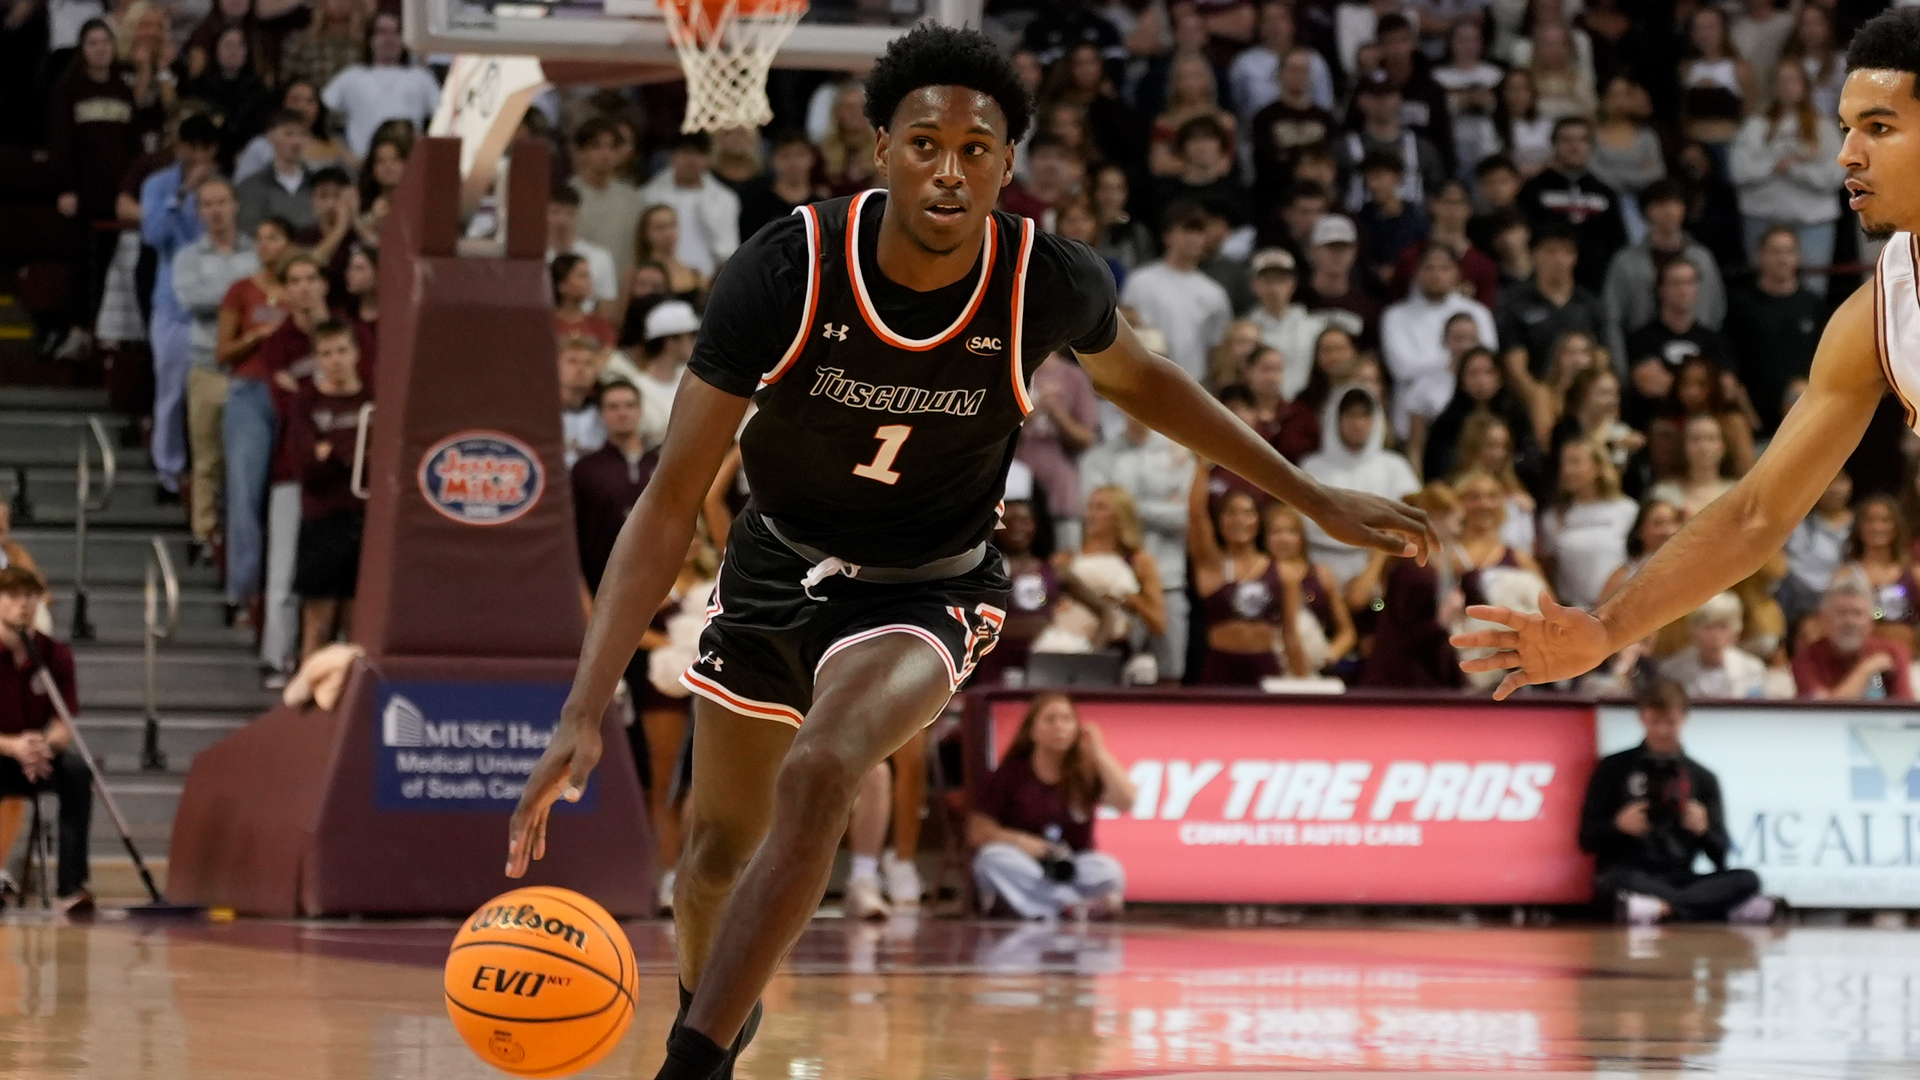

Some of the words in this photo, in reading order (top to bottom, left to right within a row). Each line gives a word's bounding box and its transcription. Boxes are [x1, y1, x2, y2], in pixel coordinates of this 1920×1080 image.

[970, 336, 1002, 350] SAC
[809, 365, 987, 417] TUSCULUM
[852, 424, 914, 486] 1
[424, 722, 505, 749] MUSC
[397, 754, 474, 774] Medical
[402, 778, 425, 799] of
[427, 776, 486, 799] South
[487, 778, 527, 799] Car
[1223, 759, 1371, 820] TIRE
[1370, 760, 1556, 821] PROS
[1179, 823, 1296, 846] COMPLETE
[1299, 823, 1361, 846] AUTO
[1363, 823, 1423, 846] CARE
[470, 903, 590, 954] Wilson
[472, 964, 547, 998] EVO
[547, 974, 573, 987] NXT
